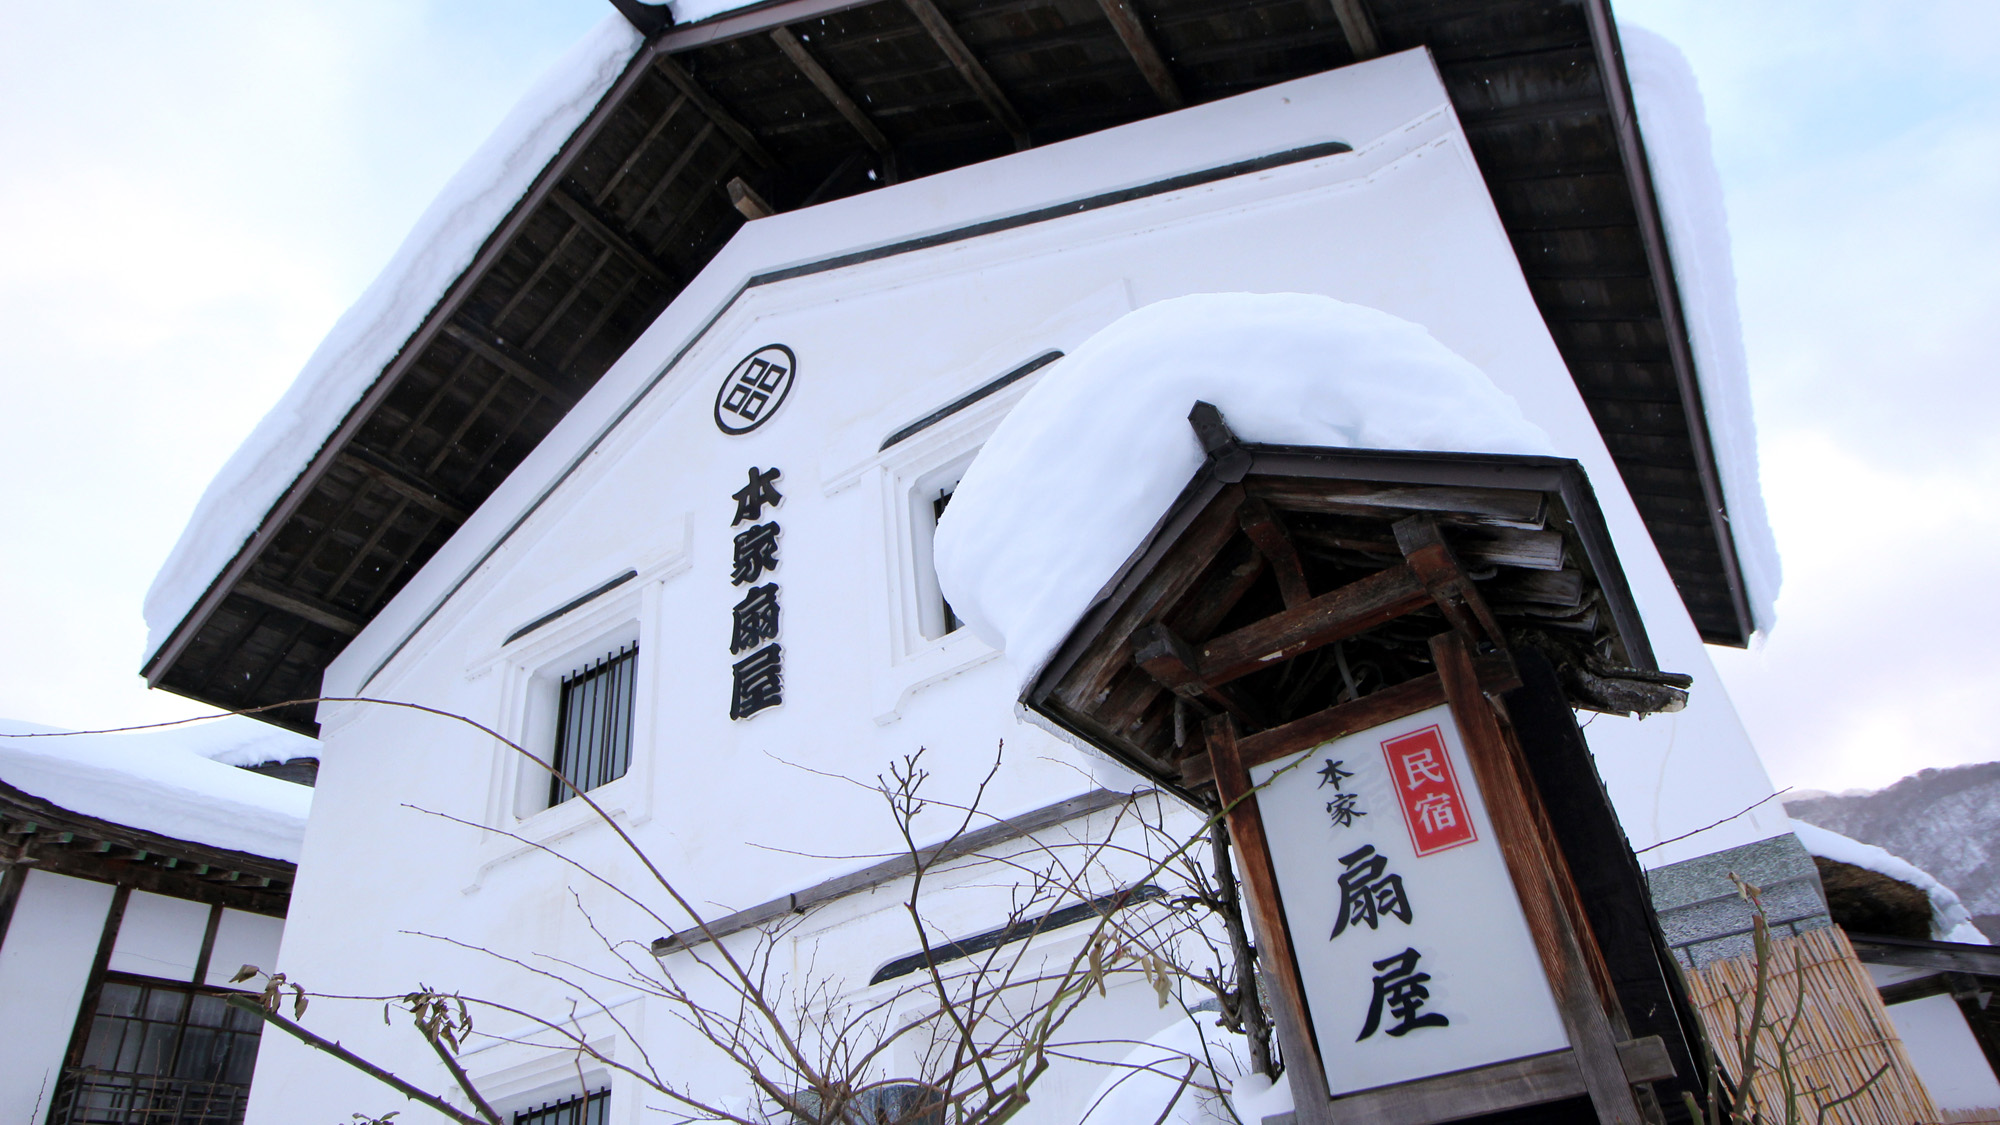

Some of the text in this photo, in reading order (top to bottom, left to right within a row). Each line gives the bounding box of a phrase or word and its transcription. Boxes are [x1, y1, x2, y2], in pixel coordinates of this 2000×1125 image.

[730, 466, 783, 721] 本家扇屋
[1403, 748, 1457, 834] 民宿
